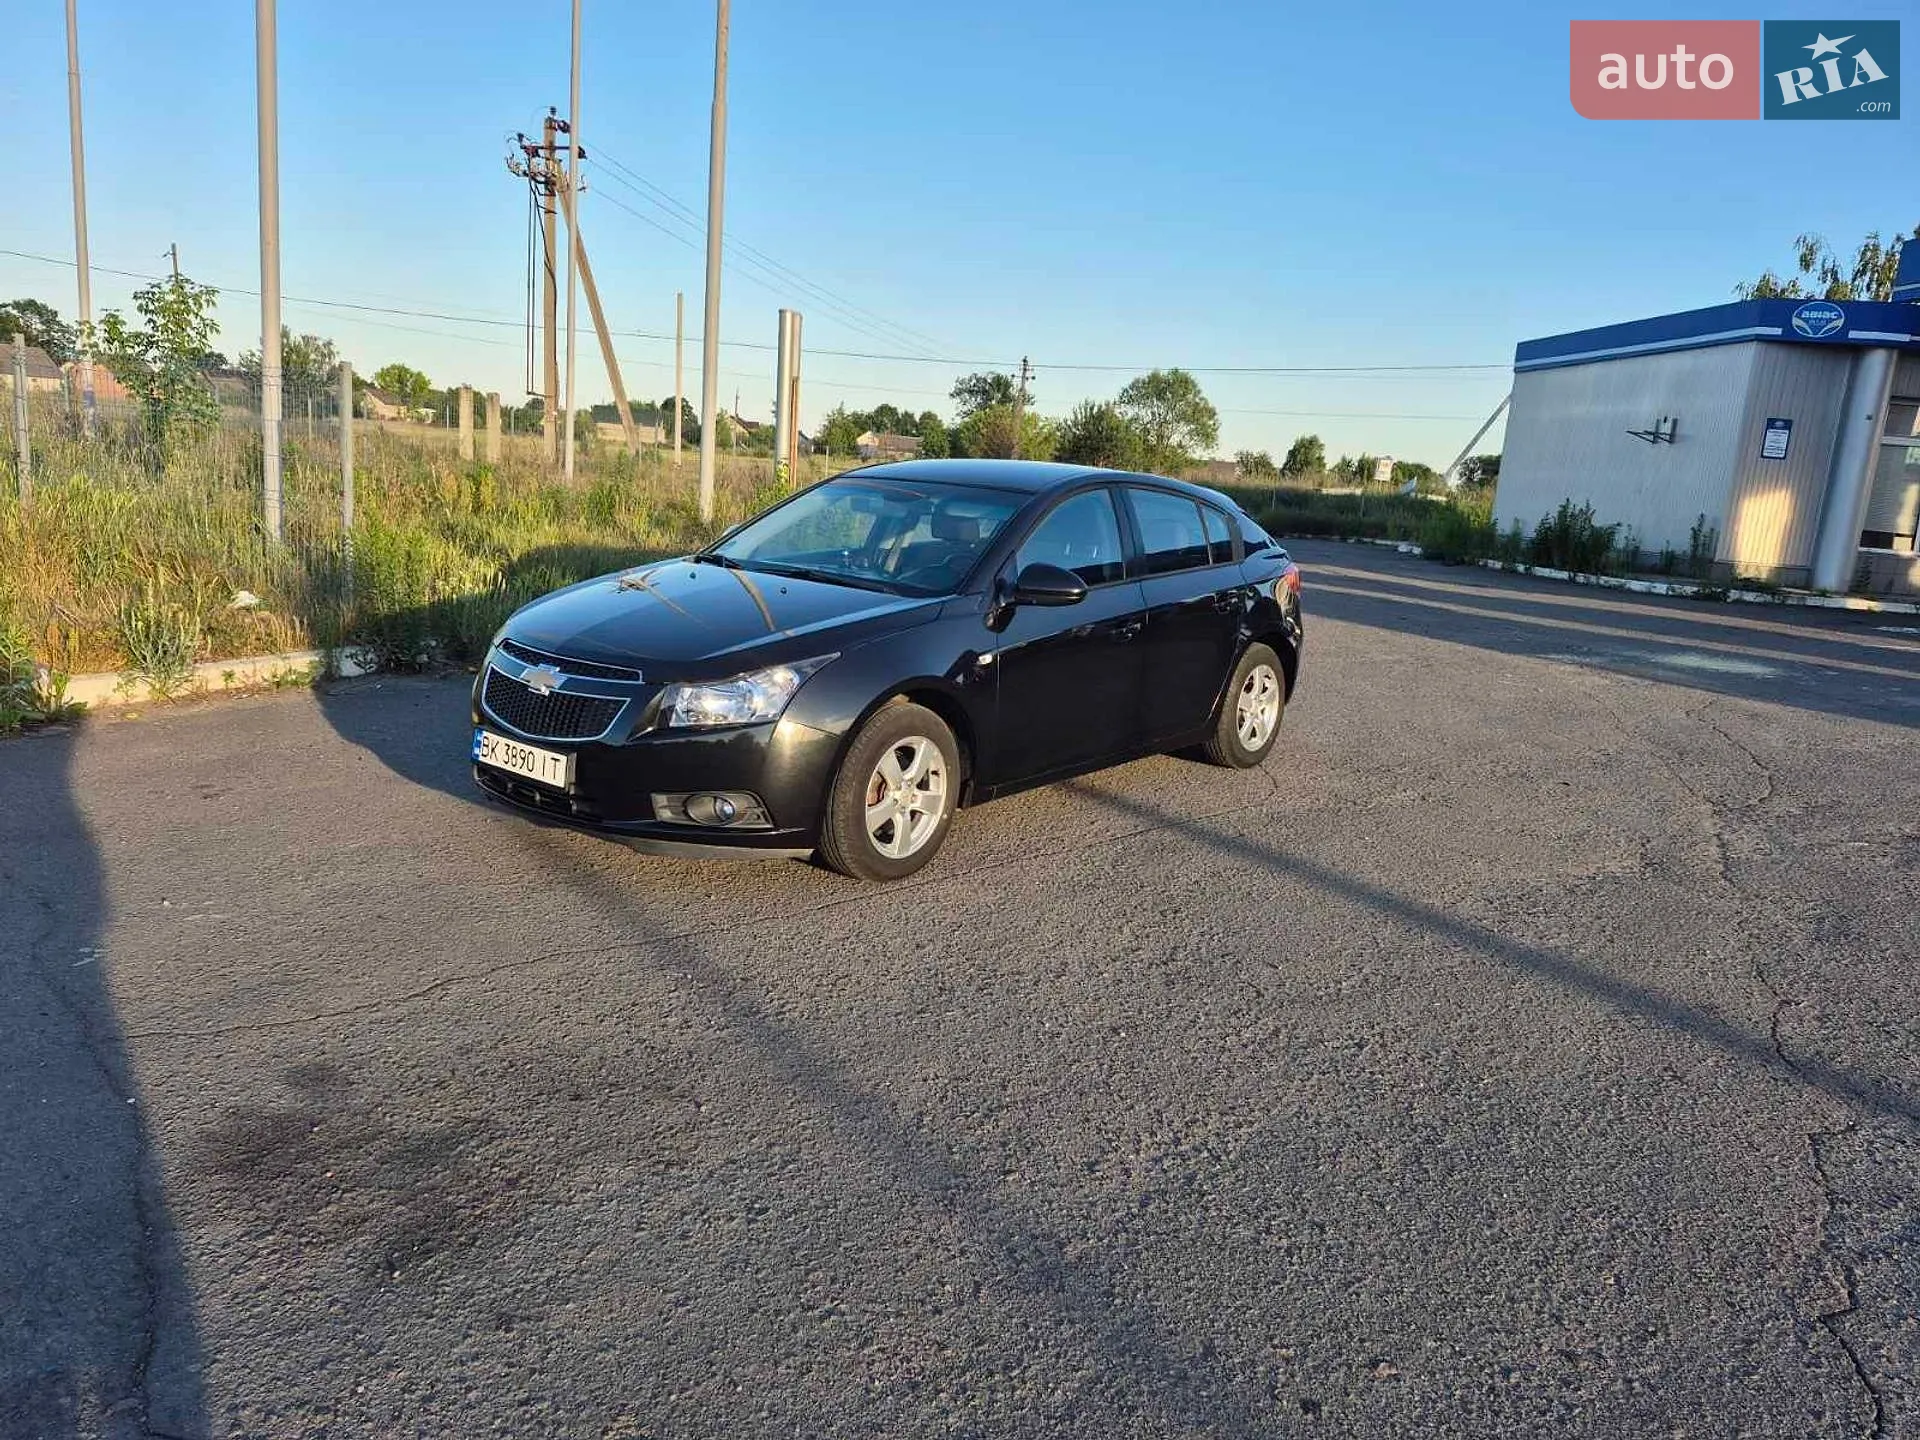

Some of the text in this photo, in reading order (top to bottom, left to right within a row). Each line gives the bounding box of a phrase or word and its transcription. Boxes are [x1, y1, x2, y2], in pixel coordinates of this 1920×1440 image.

[481, 736, 560, 780] BK 3890 IT
